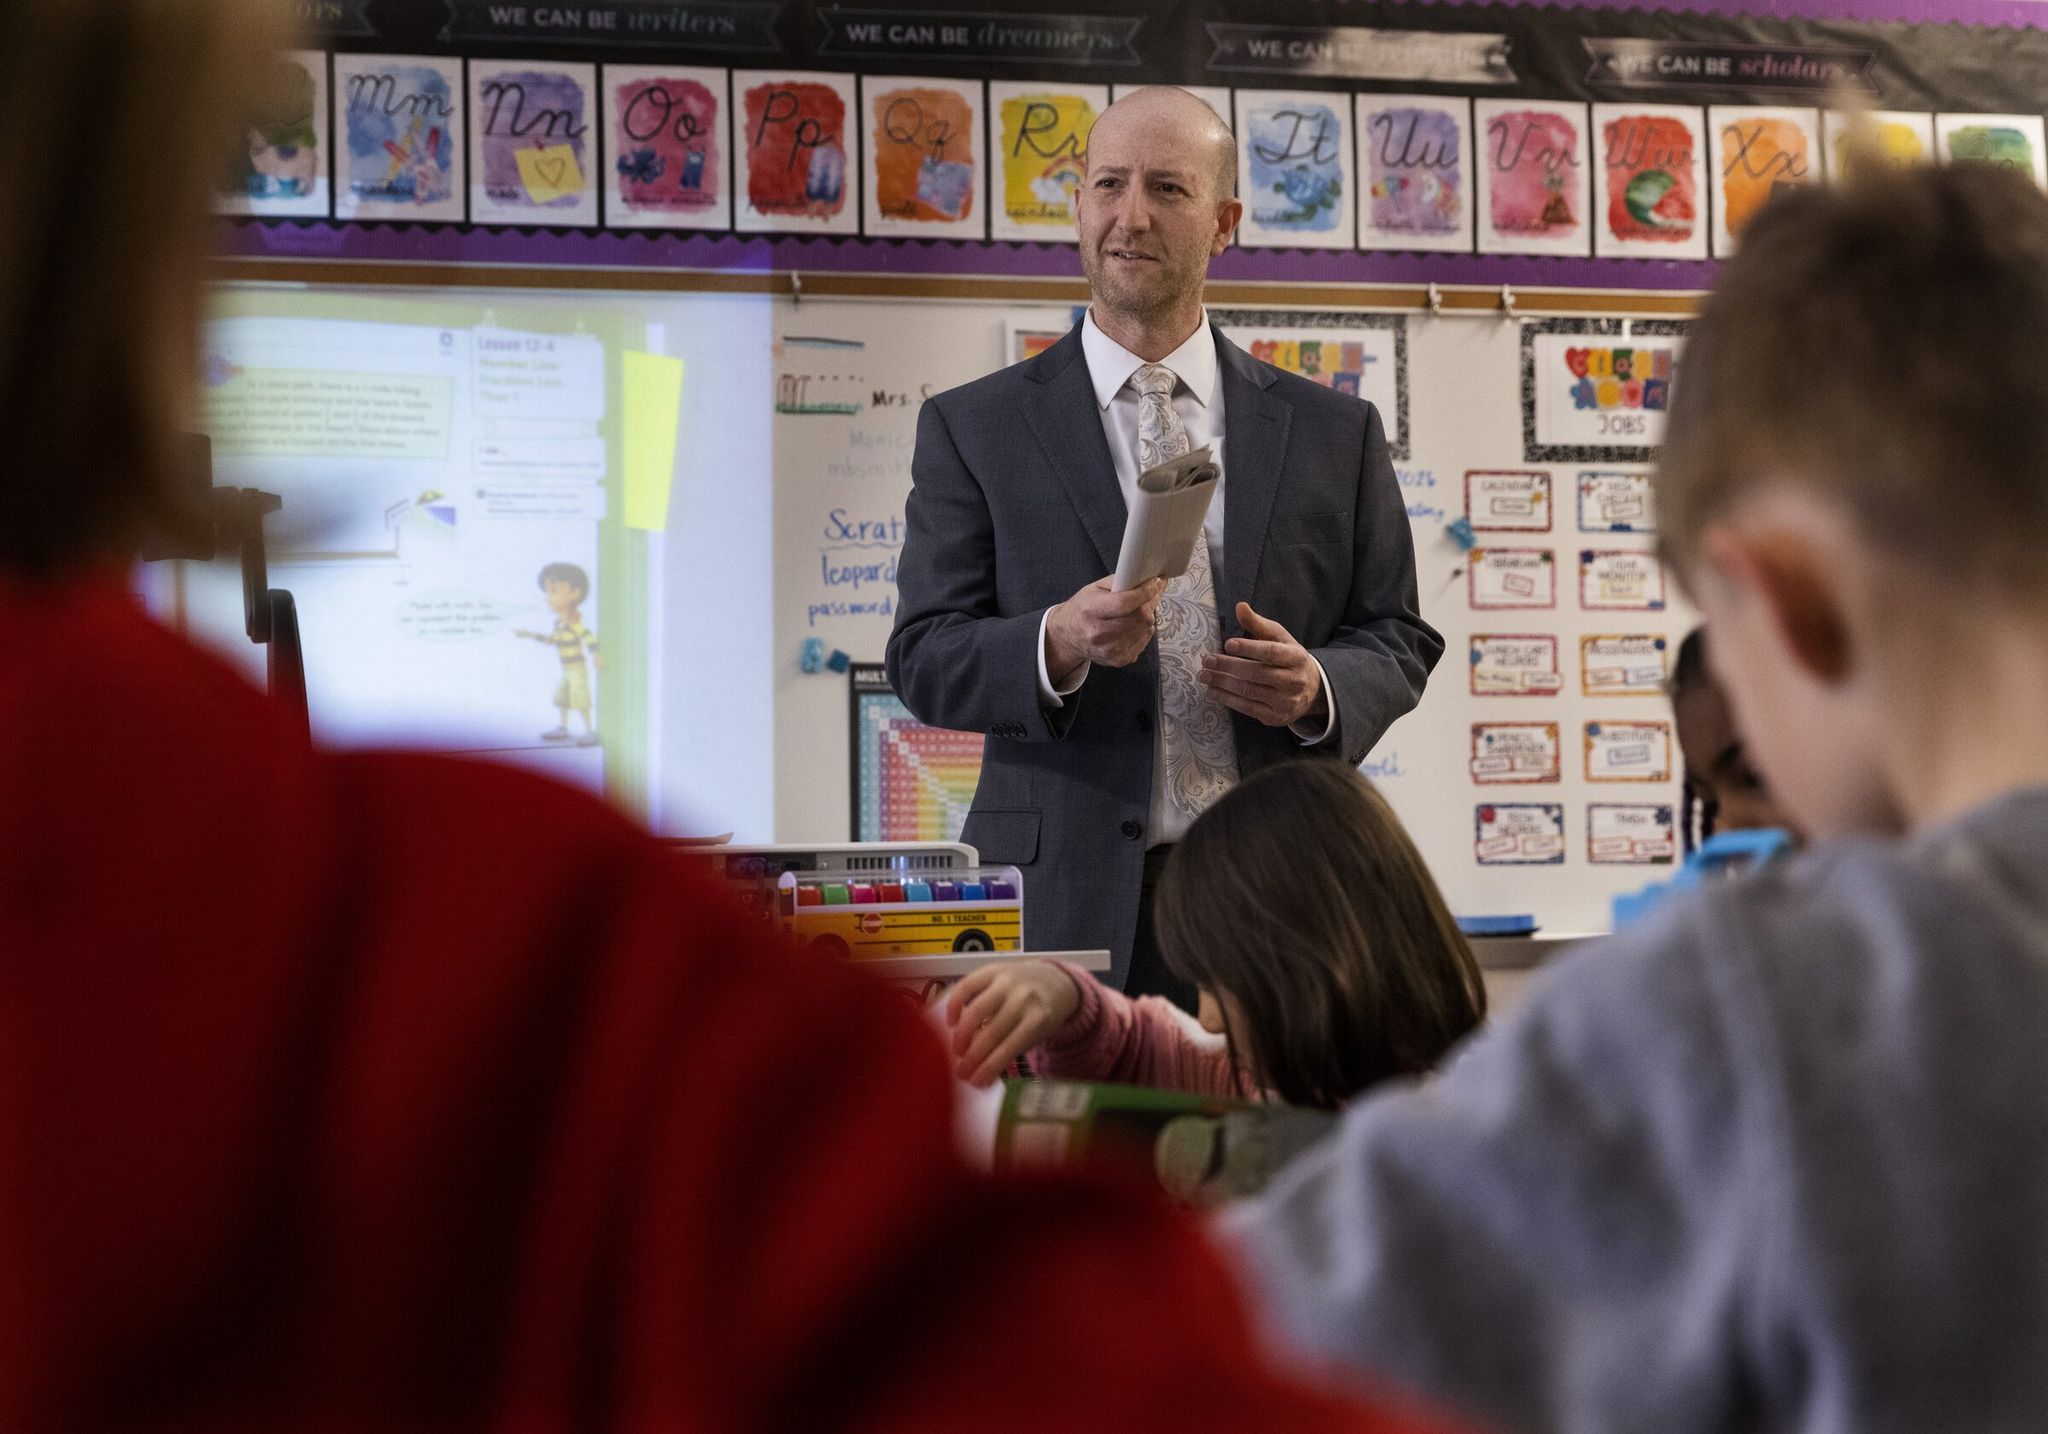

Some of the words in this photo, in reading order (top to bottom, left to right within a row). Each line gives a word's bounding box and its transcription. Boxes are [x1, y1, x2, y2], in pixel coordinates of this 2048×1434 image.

[489, 6, 527, 25] WE
[533, 9, 581, 28] CAN
[588, 11, 617, 30] BE
[847, 23, 882, 43] WE
[888, 25, 935, 45] CAN
[941, 27, 969, 46] BE
[1248, 40, 1283, 58] WE
[1657, 55, 1700, 74] CAN
[1705, 56, 1732, 76] BE
[1598, 414, 1646, 435] JOBS
[824, 508, 907, 542] Scrat
[808, 596, 893, 627] password
[953, 914, 987, 922] TEACHER
